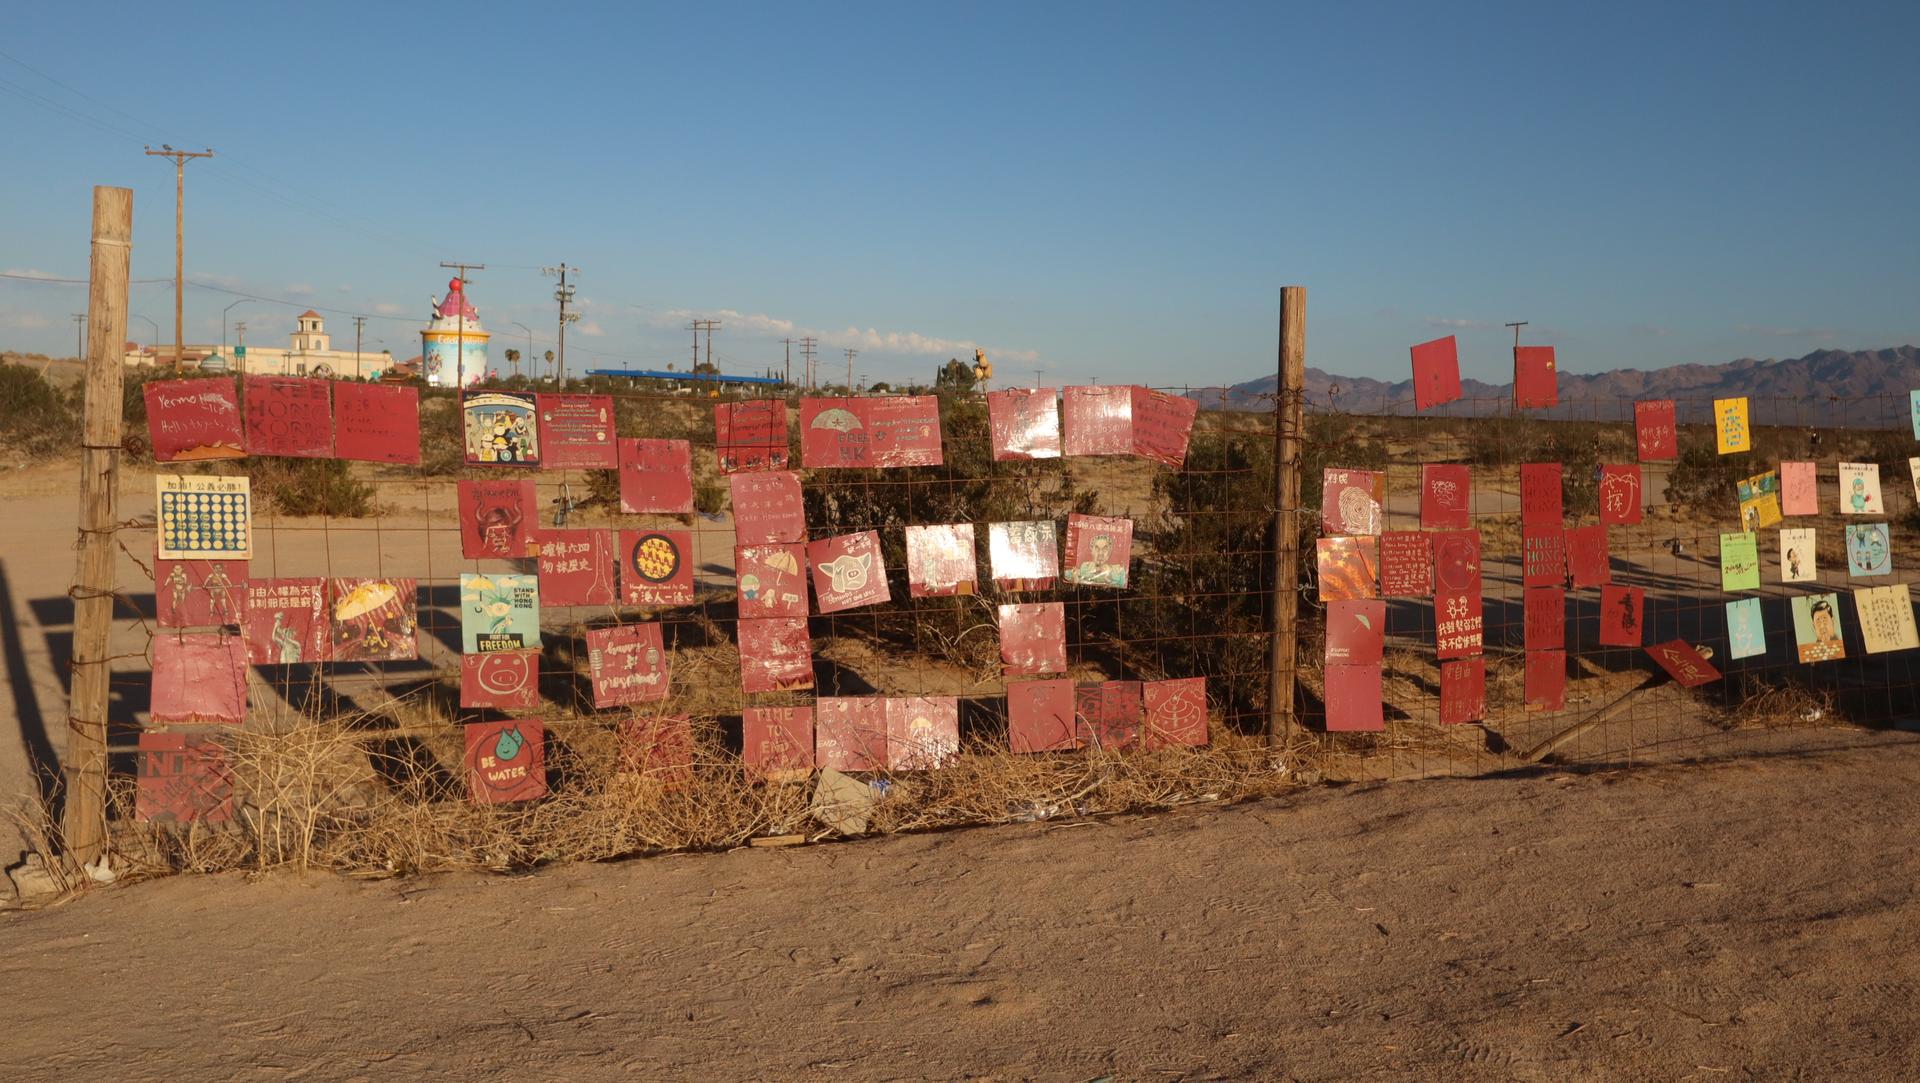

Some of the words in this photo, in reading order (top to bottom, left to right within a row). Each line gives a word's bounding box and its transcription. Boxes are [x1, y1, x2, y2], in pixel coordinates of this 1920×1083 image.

[248, 400, 326, 418] HONG
[250, 419, 327, 437] KONG
[1526, 536, 1560, 550] FREE
[1526, 550, 1561, 563] HONG
[1526, 563, 1562, 577] KONG
[480, 640, 521, 651] FREEDOM
[753, 707, 794, 723] TIME
[766, 724, 783, 738] TO
[481, 756, 496, 769] BE
[488, 766, 527, 782] WATER
